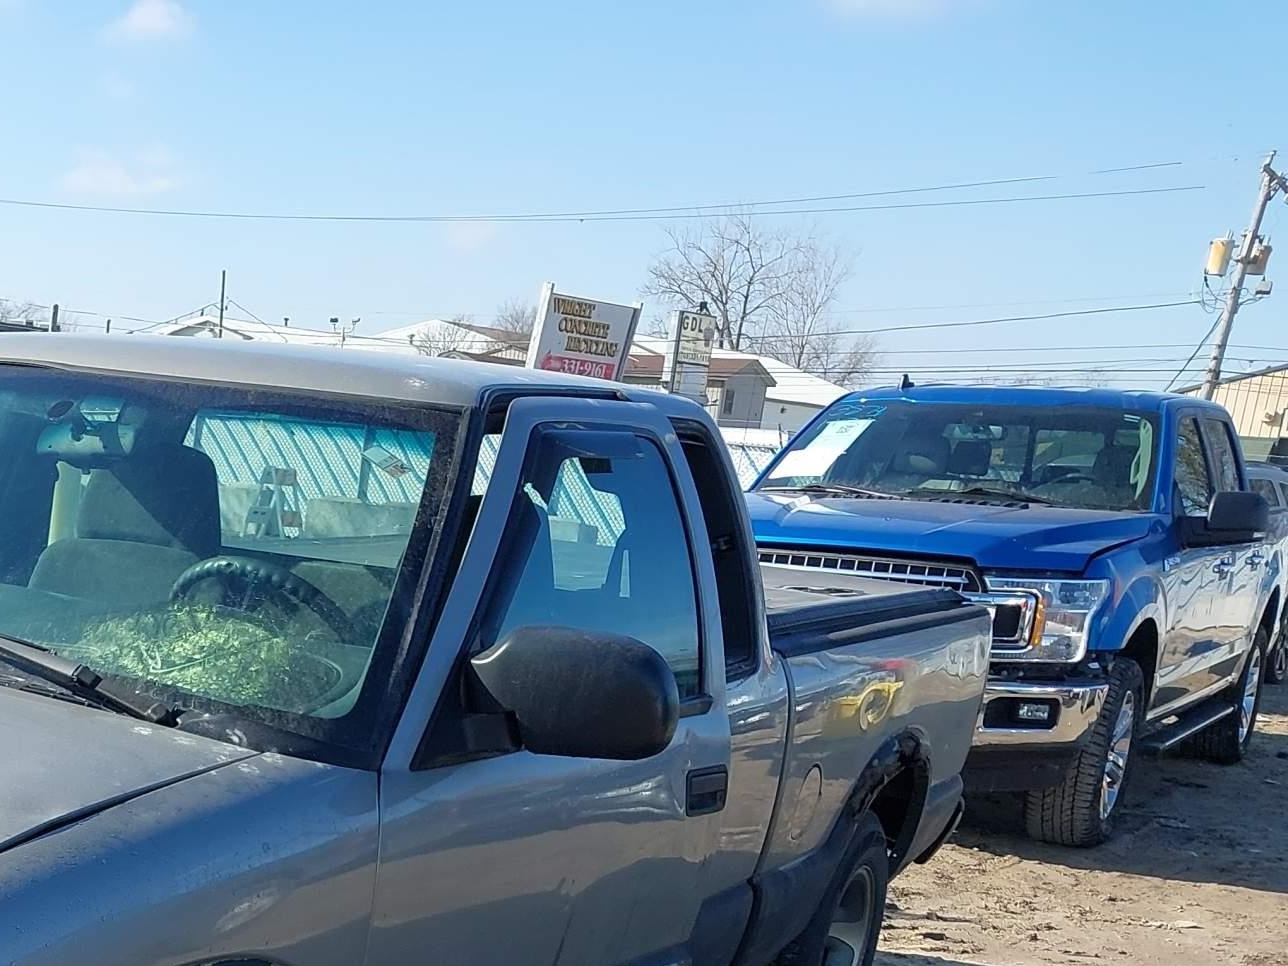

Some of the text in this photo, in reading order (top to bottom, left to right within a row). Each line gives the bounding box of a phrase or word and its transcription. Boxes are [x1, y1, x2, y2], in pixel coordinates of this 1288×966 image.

[558, 316, 610, 339] CONCRETE
[682, 315, 704, 334] GDL
[565, 336, 618, 358] RECYCLING
